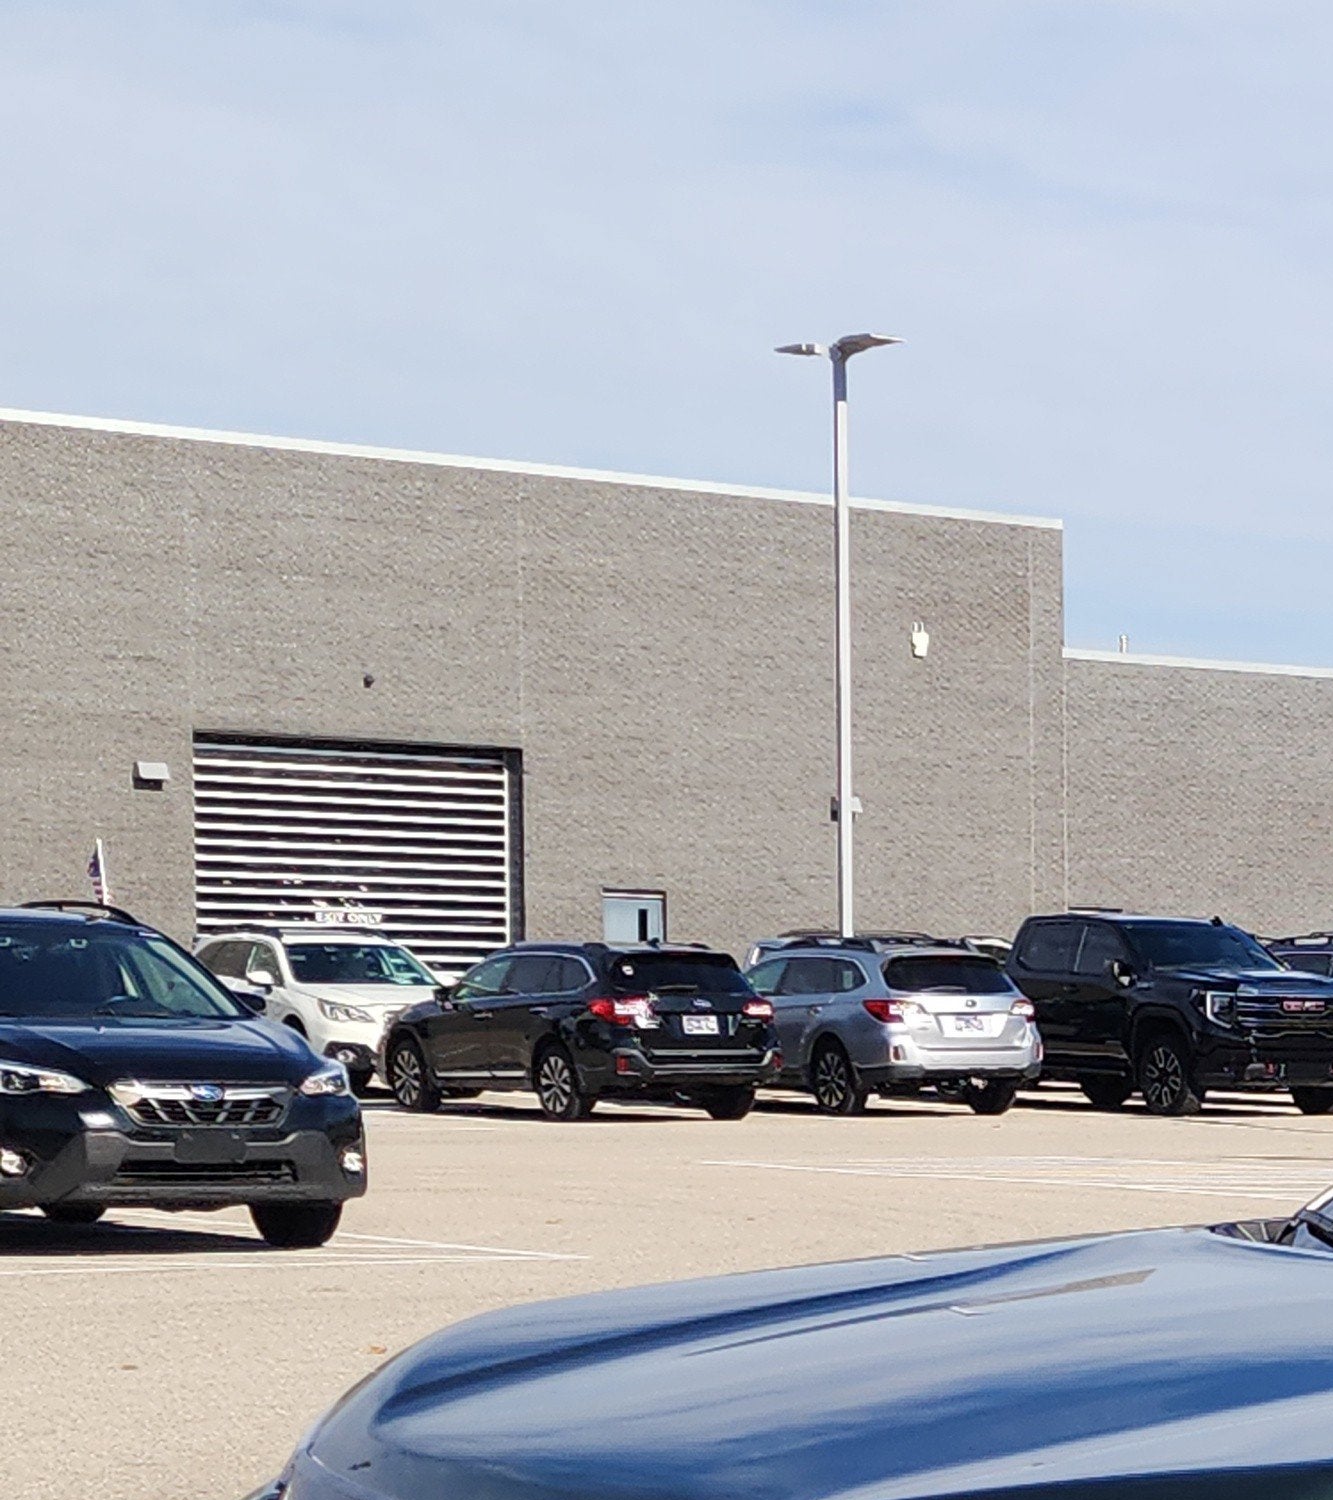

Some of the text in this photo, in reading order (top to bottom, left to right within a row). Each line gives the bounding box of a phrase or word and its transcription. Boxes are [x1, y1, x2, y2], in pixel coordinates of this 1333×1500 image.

[315, 911, 382, 925] EXIT ONLY
[1283, 1001, 1325, 1011] GMC
